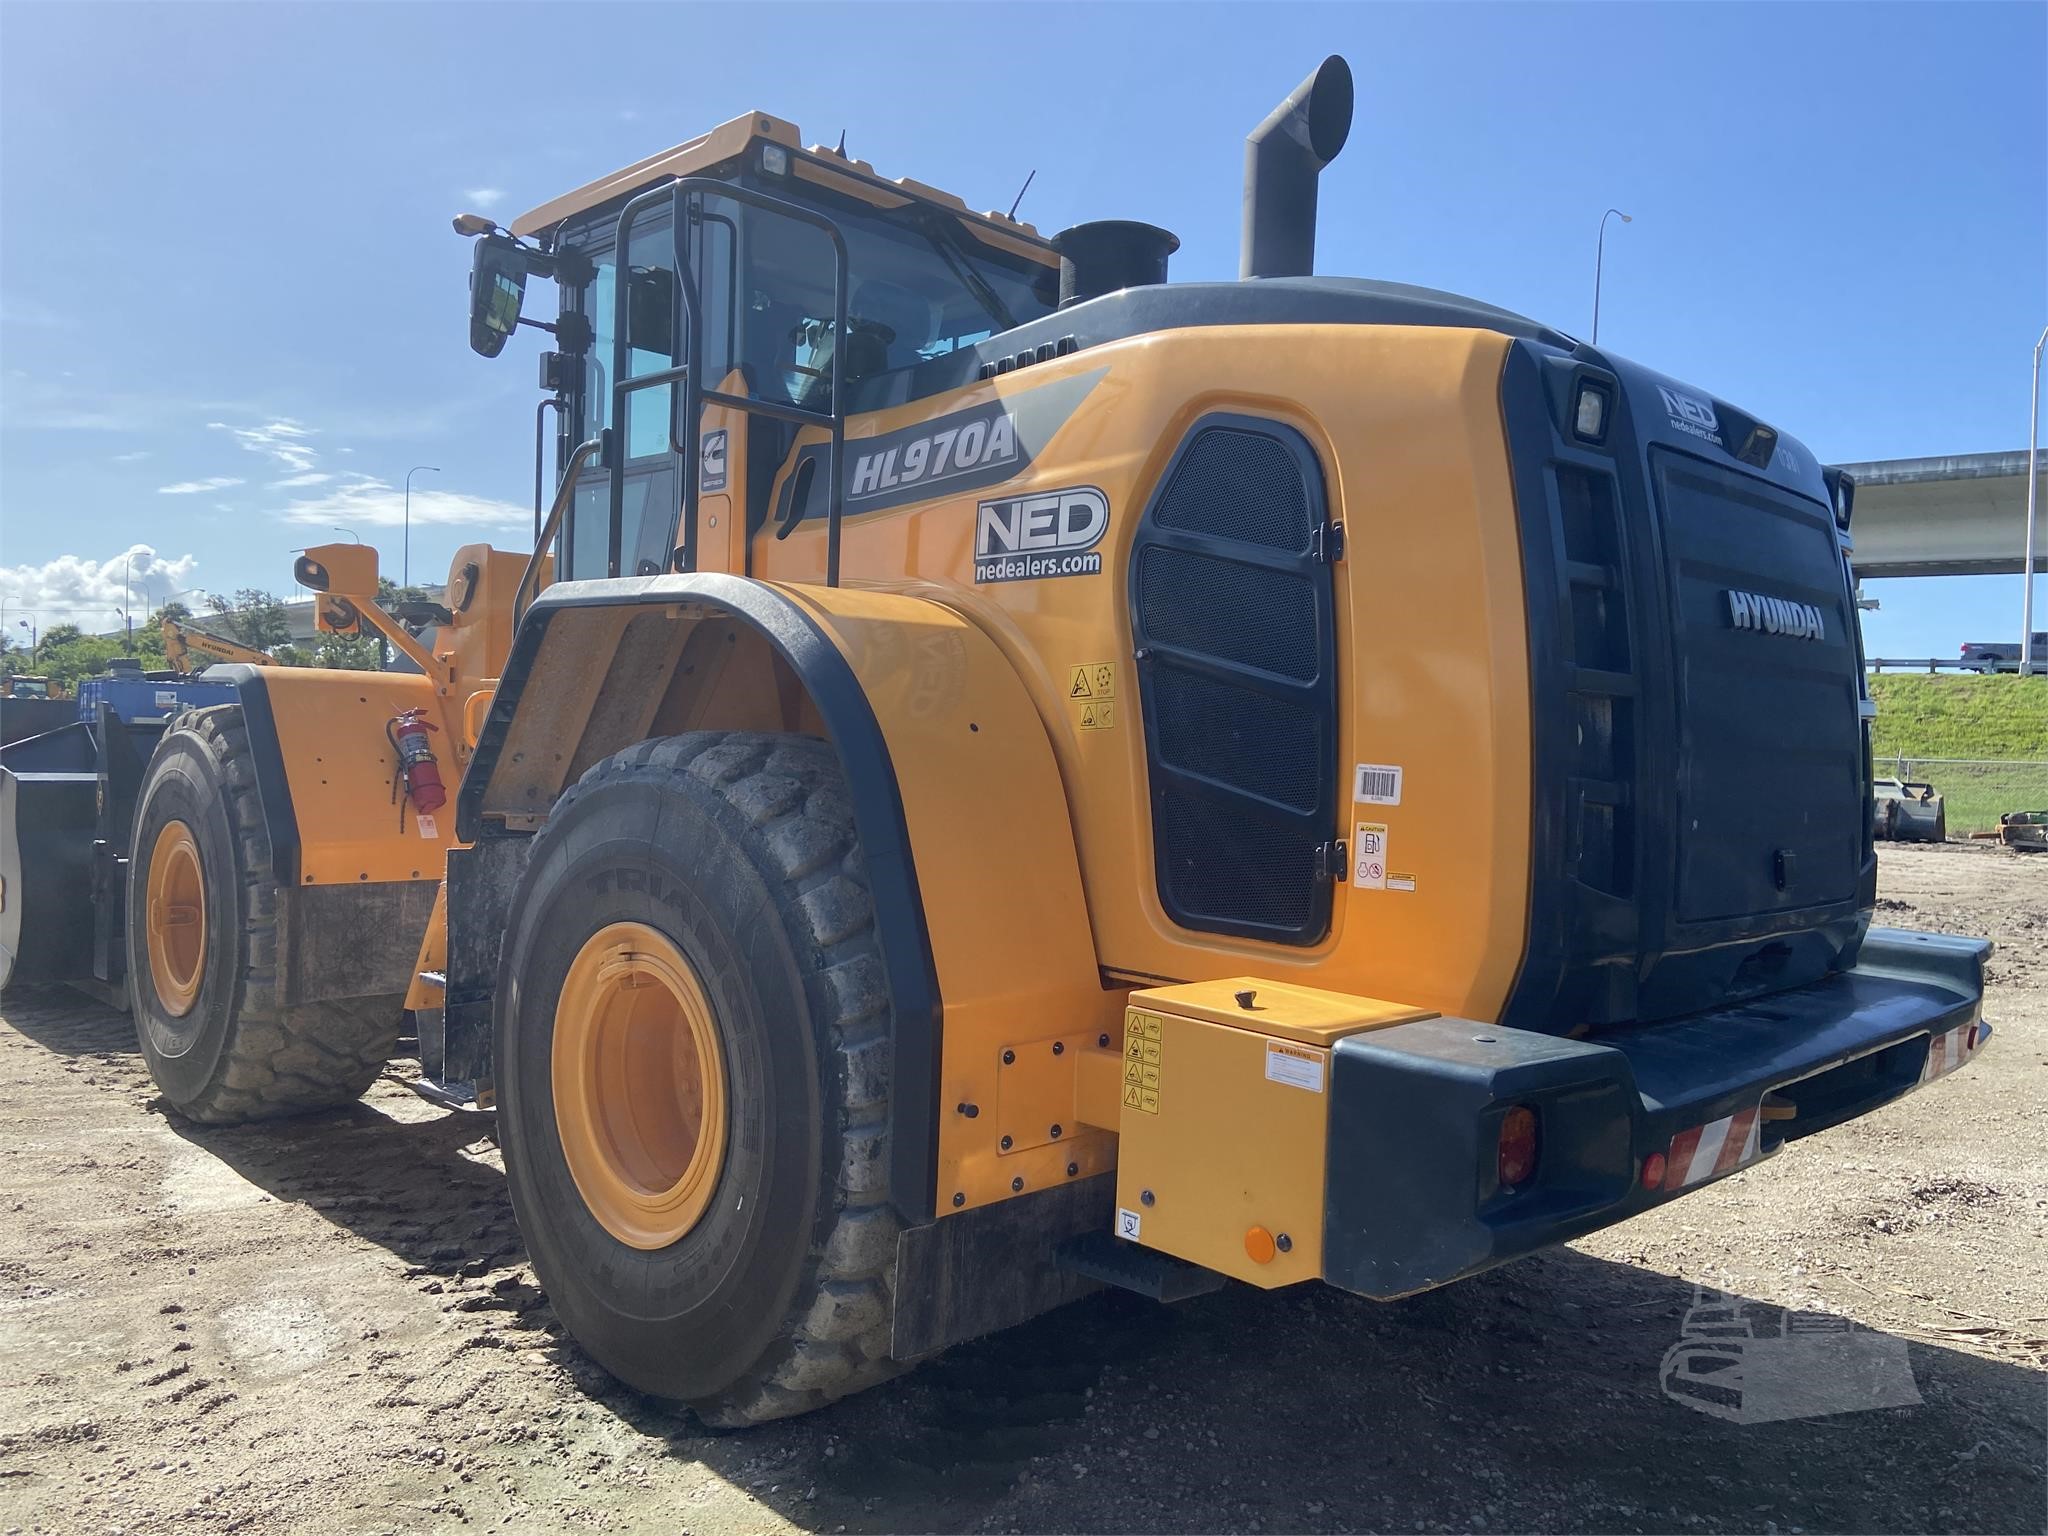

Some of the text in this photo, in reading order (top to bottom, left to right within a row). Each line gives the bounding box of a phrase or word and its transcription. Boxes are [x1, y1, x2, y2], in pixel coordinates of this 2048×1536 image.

[1658, 387, 1717, 429] NED
[852, 413, 1014, 494] HL970A
[978, 492, 1105, 554] NED
[976, 555, 1100, 580] nedealers.com
[1728, 590, 1825, 640] HYUNDAI
[201, 642, 234, 656] HYUNDAI
